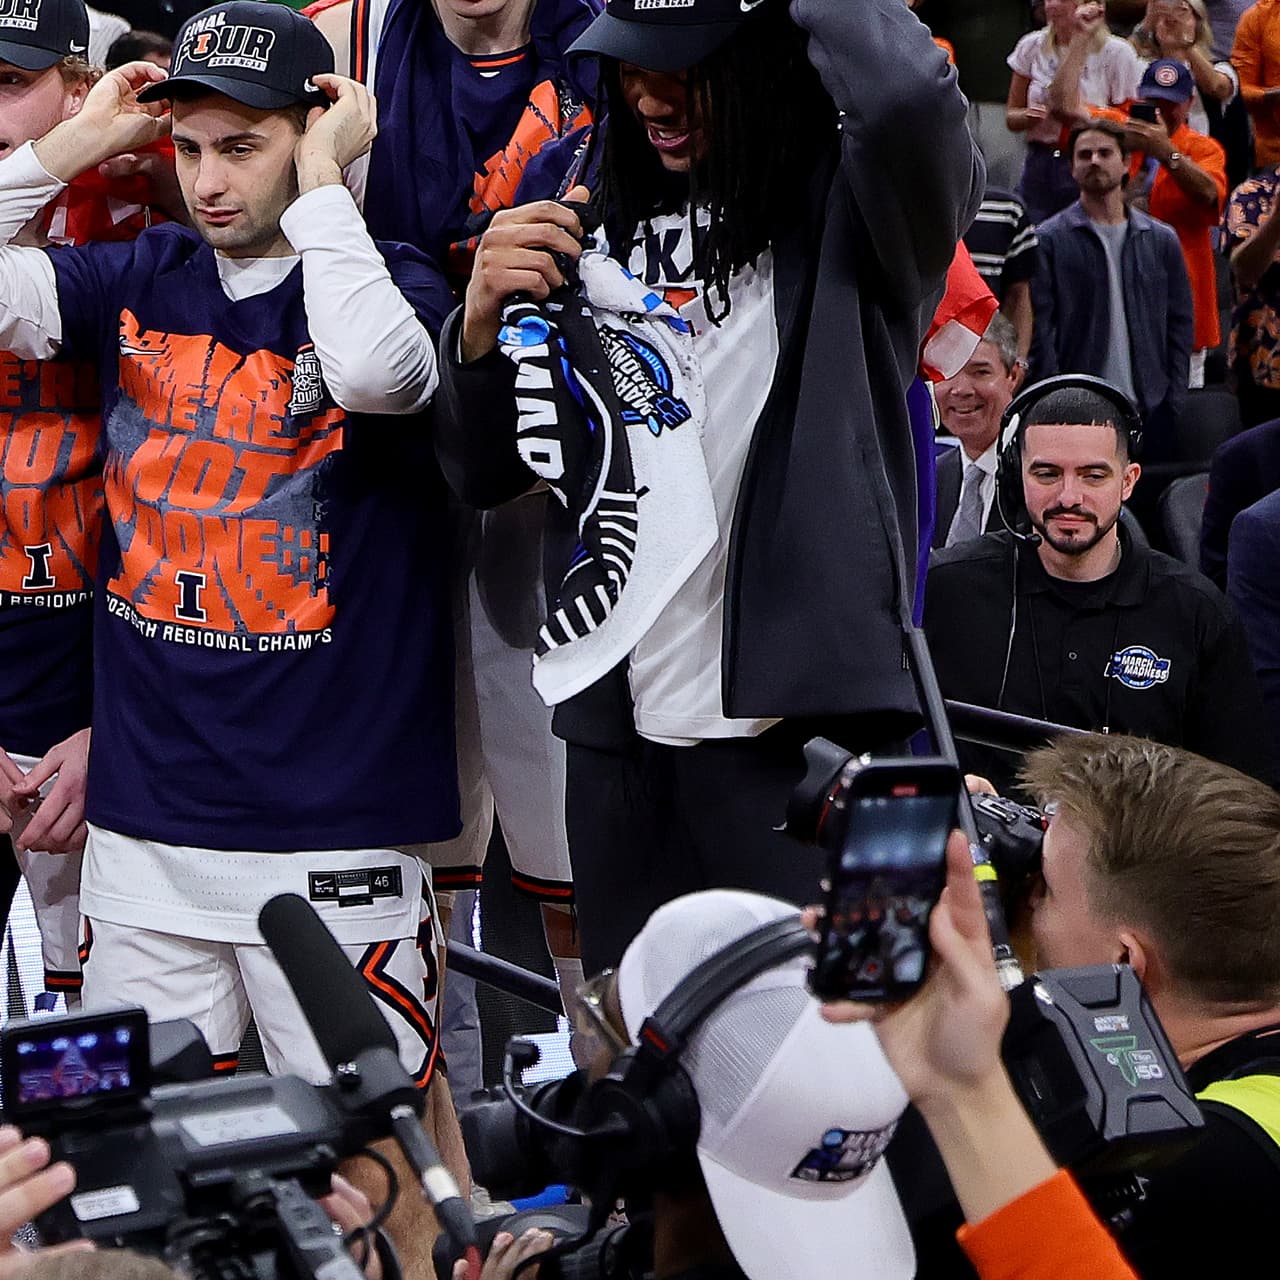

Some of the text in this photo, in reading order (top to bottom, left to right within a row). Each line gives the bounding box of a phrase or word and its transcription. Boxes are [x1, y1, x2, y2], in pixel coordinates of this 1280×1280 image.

[184, 12, 226, 39] FINAL
[131, 426, 290, 515] NOT
[133, 507, 280, 573] DONE
[22, 543, 55, 589] I
[174, 570, 207, 622] I
[164, 624, 250, 653] REGIONAL
[1122, 656, 1154, 669] MARCH
[1125, 666, 1168, 680] MADNESS
[374, 876, 390, 888] 46
